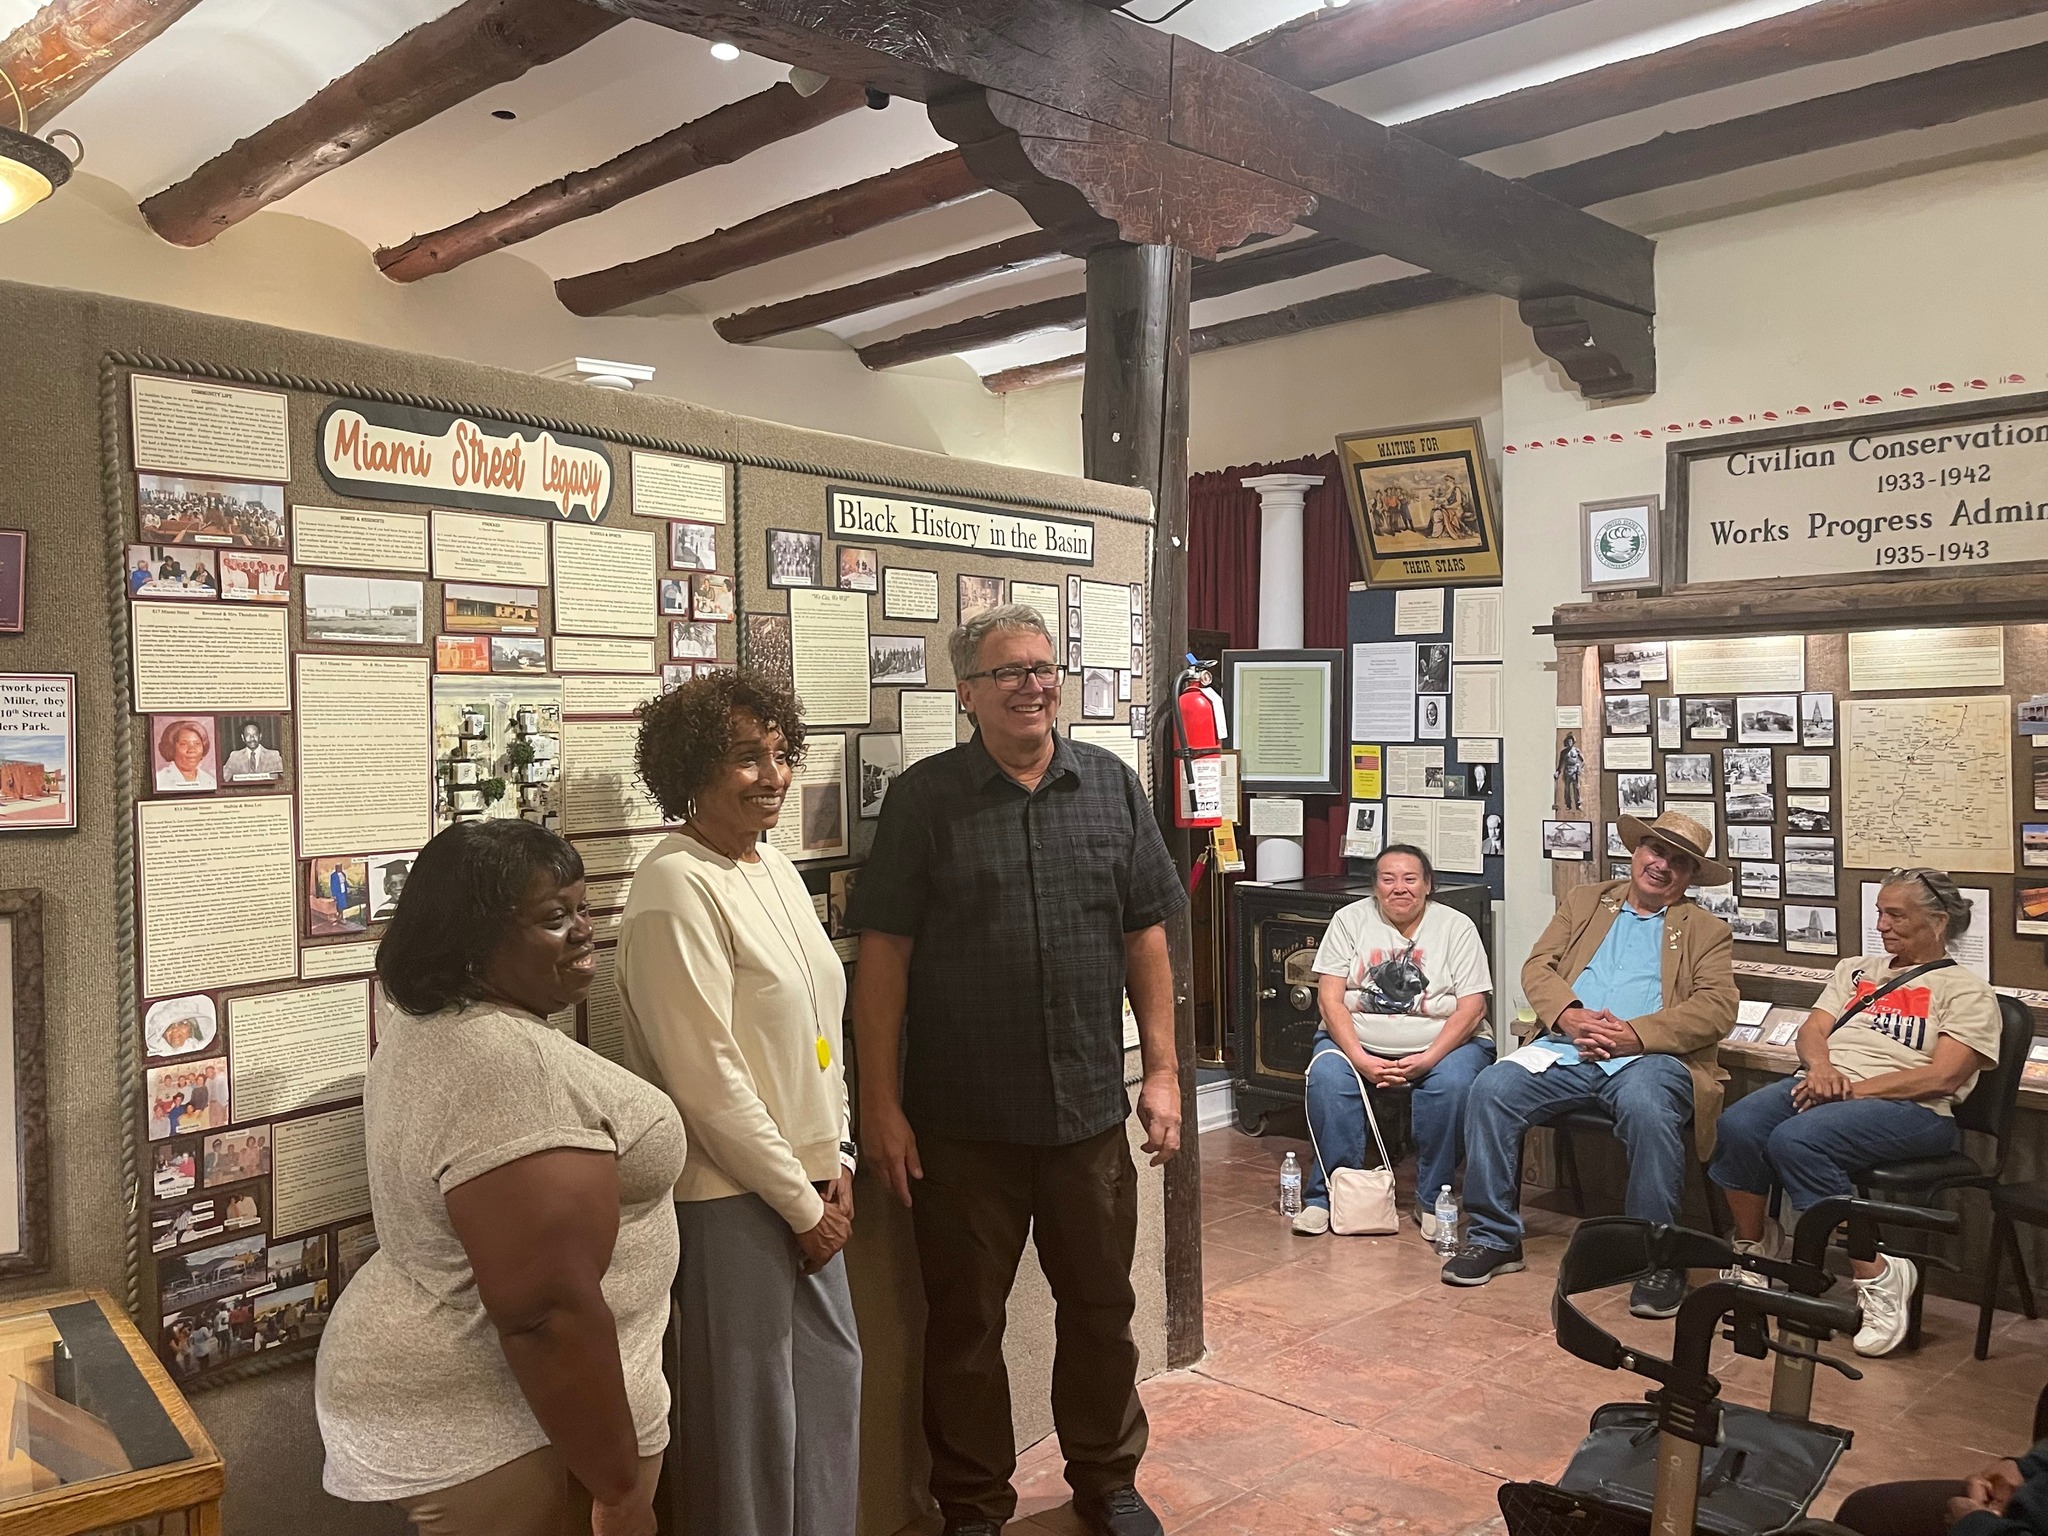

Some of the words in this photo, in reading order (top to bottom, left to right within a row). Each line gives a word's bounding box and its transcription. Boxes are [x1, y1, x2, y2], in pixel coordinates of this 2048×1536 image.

[1377, 441, 1416, 458] WAITING
[1420, 437, 1440, 452] FOR
[1726, 446, 1835, 476] Civilian
[1849, 423, 2048, 464] Conservation
[334, 419, 431, 477] Miami
[452, 422, 526, 492] Street
[542, 436, 602, 518] Legacy
[1877, 464, 1991, 494] 1933-1942
[838, 499, 899, 534] Black
[910, 506, 980, 548] History
[990, 519, 1005, 546] in
[1011, 522, 1038, 550] the
[1045, 526, 1088, 554] Basin
[1710, 518, 1790, 546] Works
[1808, 510, 1933, 544] Progress
[1875, 540, 1990, 566] 1935-1943
[1402, 561, 1432, 574] THEIR
[1435, 558, 1466, 572] STARS
[35, 684, 66, 694] pieces
[4, 696, 38, 705] Miller,
[44, 697, 66, 707] they
[22, 710, 53, 718] Street
[22, 722, 50, 730] Park.
